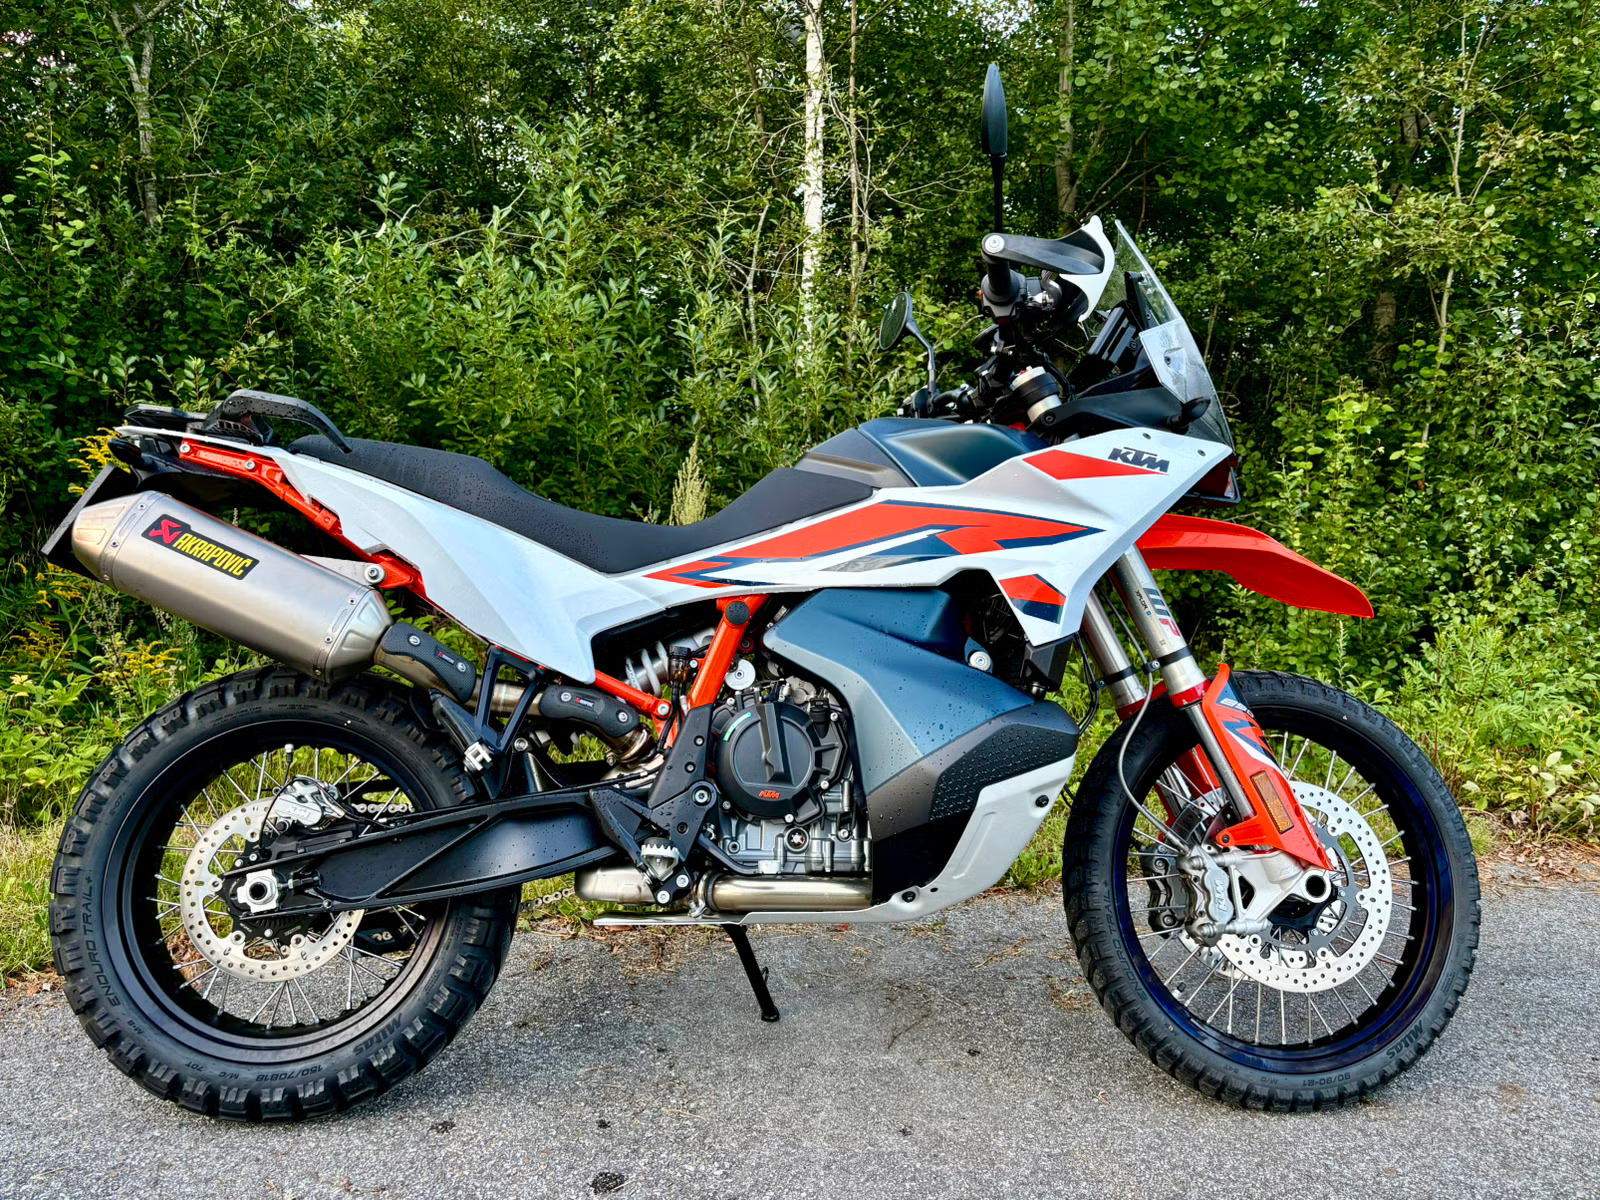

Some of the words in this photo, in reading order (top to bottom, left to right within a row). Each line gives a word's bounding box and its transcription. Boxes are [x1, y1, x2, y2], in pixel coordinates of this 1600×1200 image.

[1108, 446, 1170, 473] KTM
[758, 788, 781, 799] KTM
[86, 940, 122, 1008] ENDURO
[1112, 939, 1149, 1002] ENDURO
[1386, 1019, 1424, 1060] Mitas
